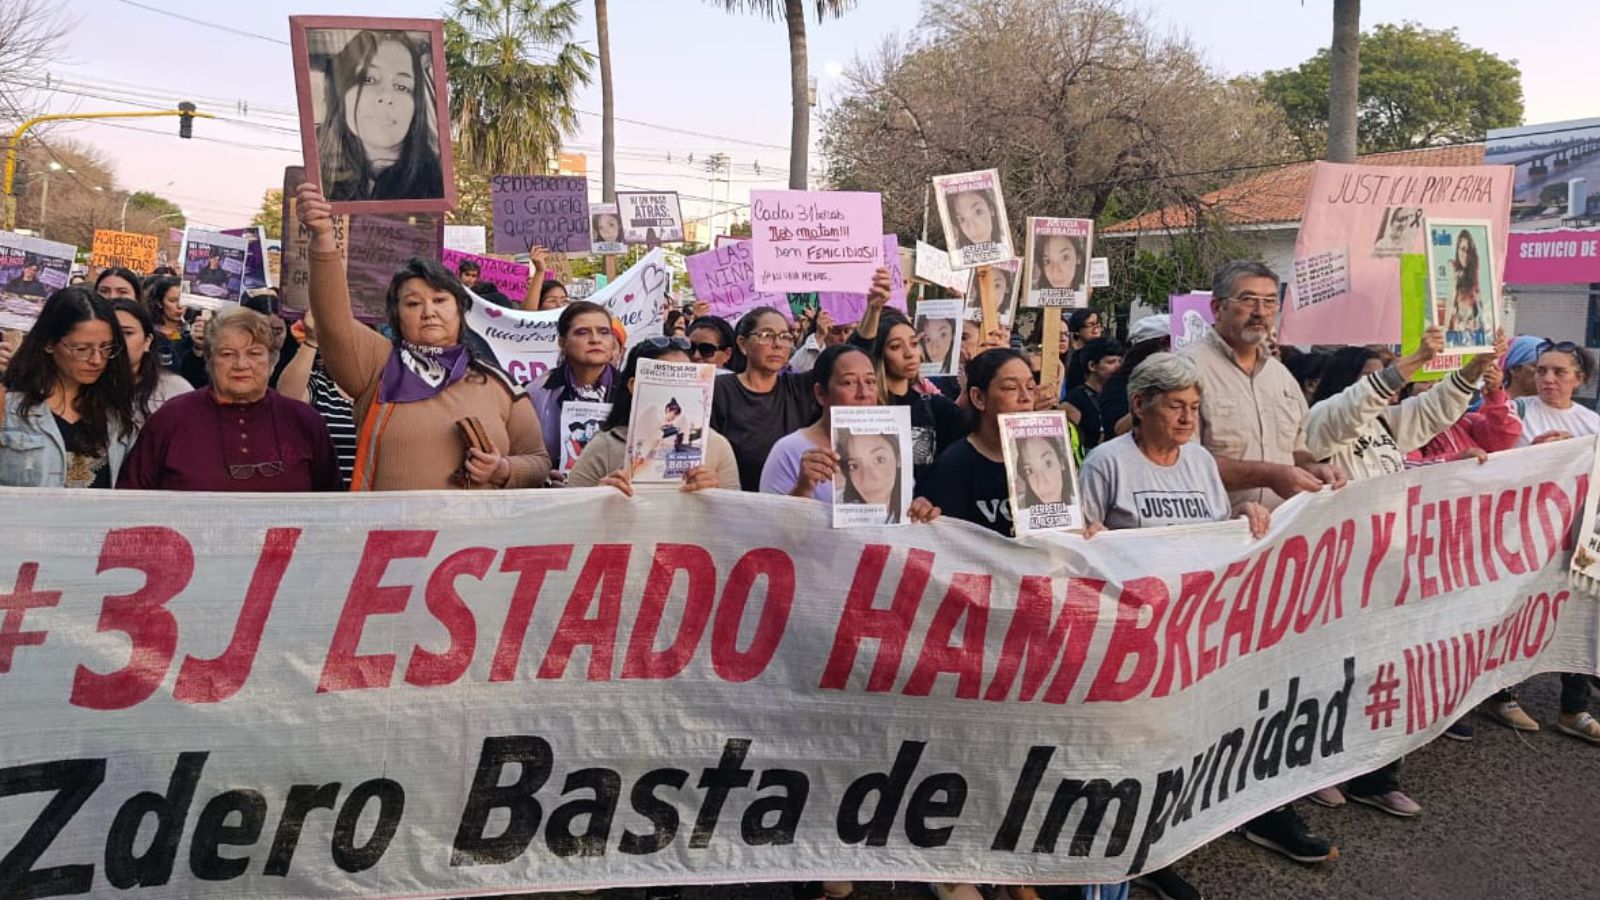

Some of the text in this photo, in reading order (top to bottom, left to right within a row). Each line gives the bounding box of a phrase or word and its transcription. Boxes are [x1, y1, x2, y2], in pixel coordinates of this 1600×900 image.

[1420, 176, 1452, 204] POR
[525, 196, 582, 214] Graciela
[755, 199, 794, 220] Cada
[715, 242, 750, 266] LAS
[1519, 240, 1598, 258] SERVICIO DE
[1026, 425, 1064, 436] GRACIELA
[1141, 497, 1211, 518] JUSTICIA
[317, 530, 797, 693] ESTADO
[820, 518, 1354, 704] HAMBREADOR
[1361, 512, 1396, 608] Y
[0, 656, 1356, 900] Zdero Basta de Impunidad
